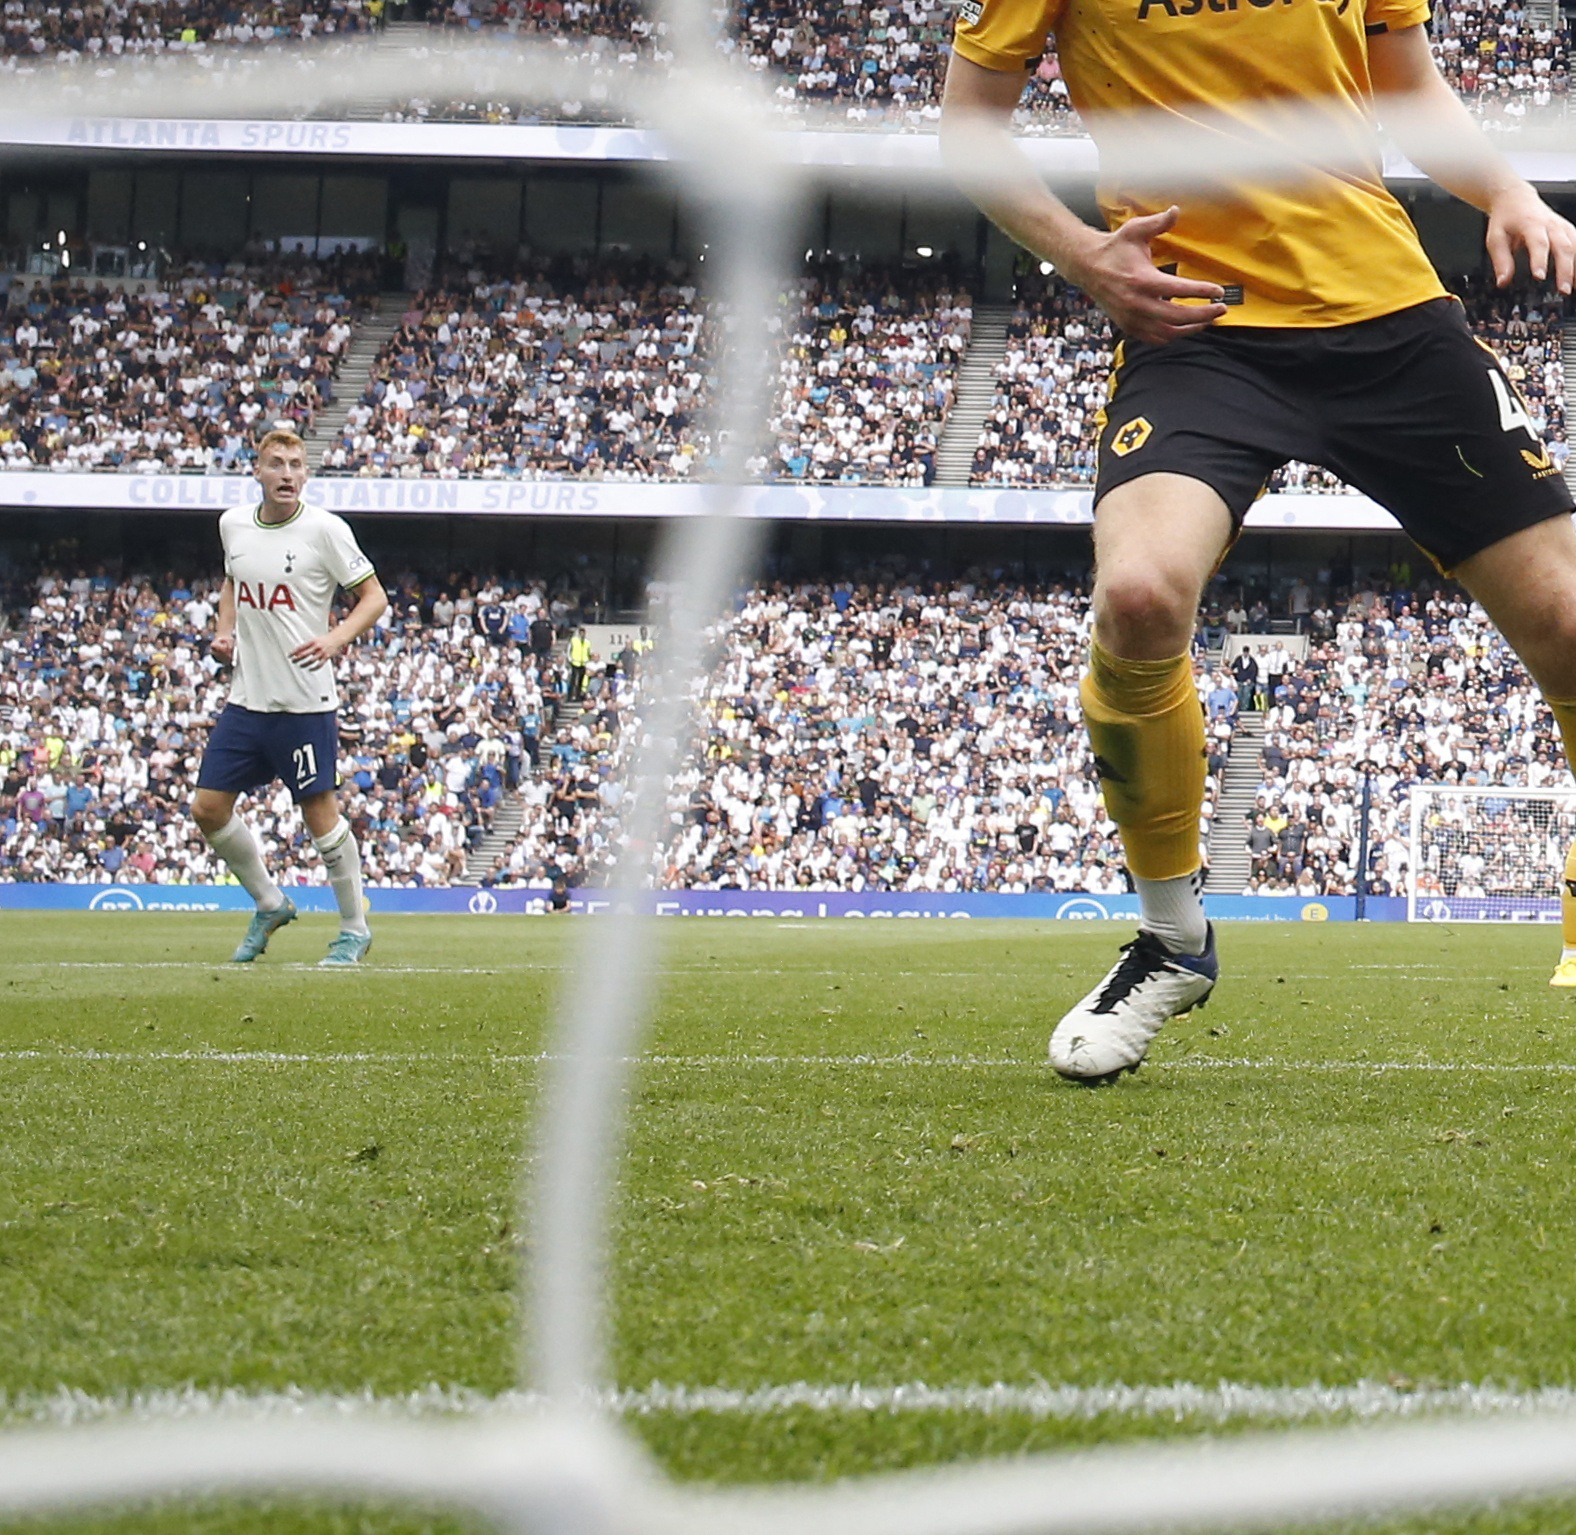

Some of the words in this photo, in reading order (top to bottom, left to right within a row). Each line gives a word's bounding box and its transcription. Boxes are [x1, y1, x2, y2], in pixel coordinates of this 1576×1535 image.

[67, 119, 221, 146] ATLANTA
[241, 123, 352, 149] SPURS
[1486, 368, 1540, 442] 4
[128, 479, 262, 508] COLLEG
[304, 481, 459, 509] STATION
[482, 484, 600, 511] SPURS
[237, 581, 297, 612] AIA
[292, 743, 318, 781] 21
